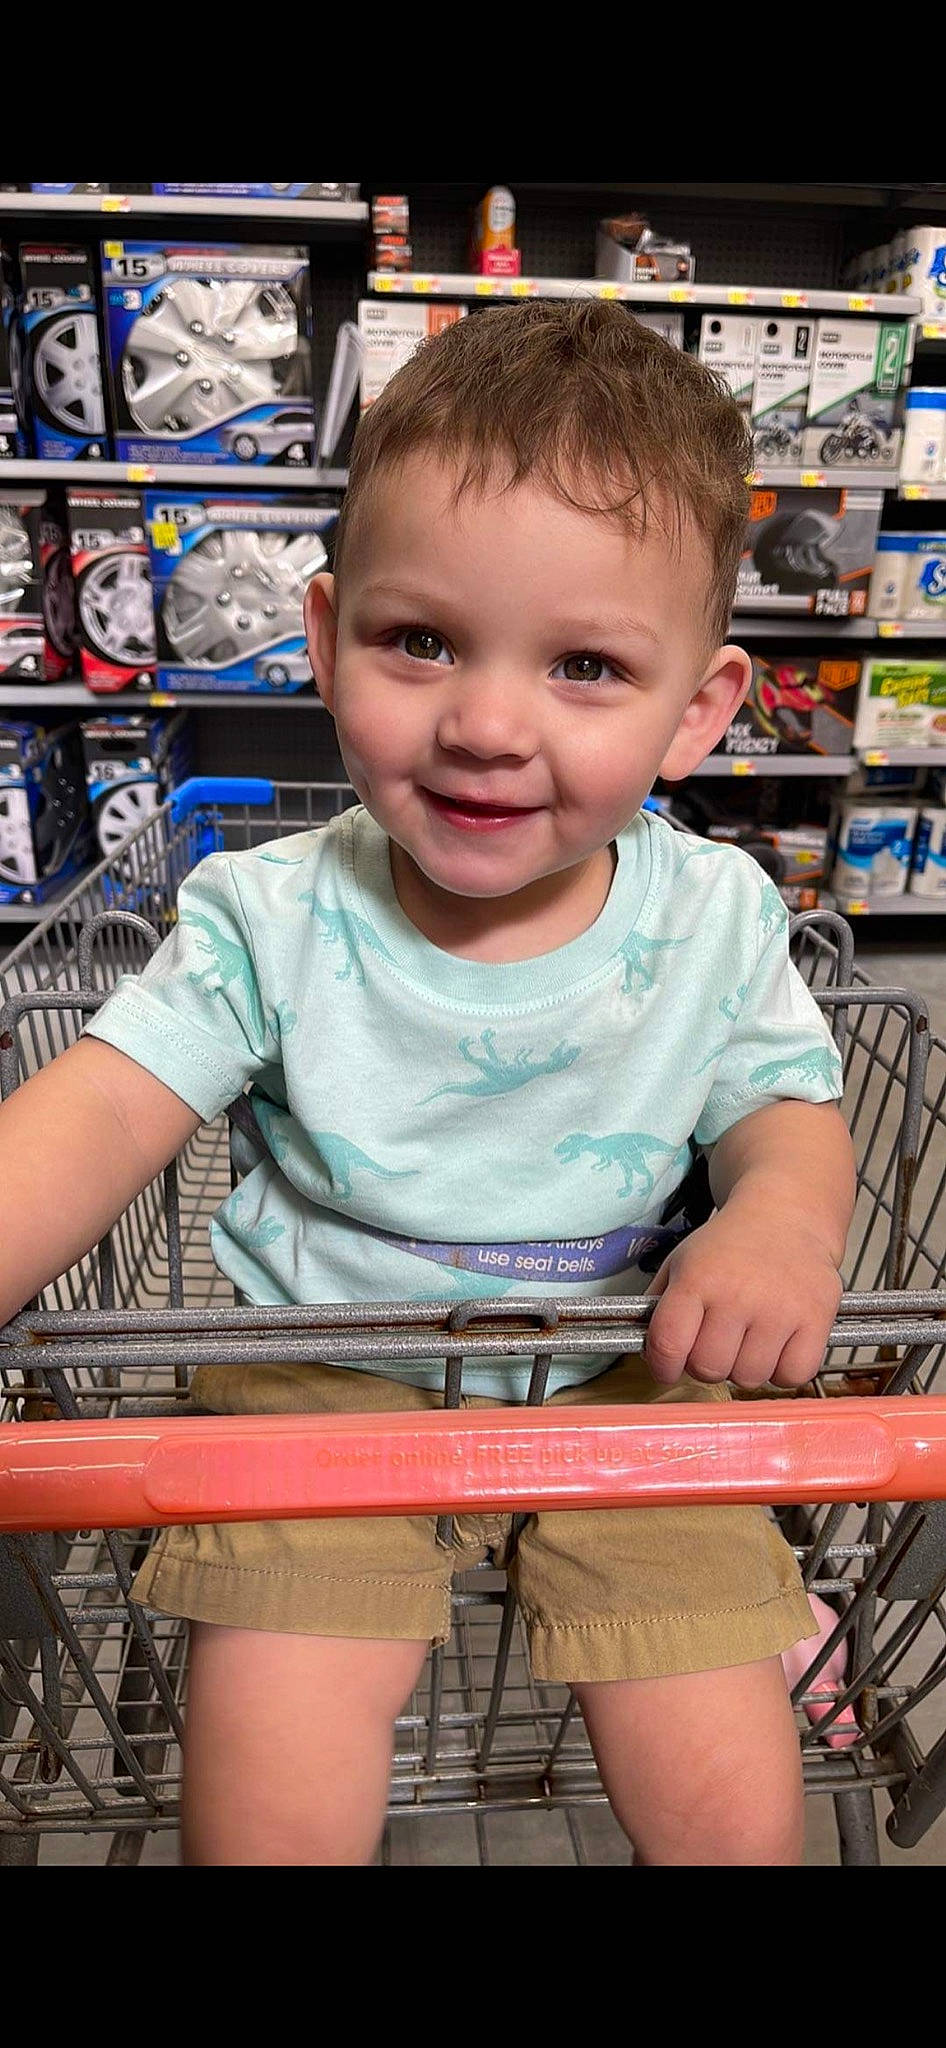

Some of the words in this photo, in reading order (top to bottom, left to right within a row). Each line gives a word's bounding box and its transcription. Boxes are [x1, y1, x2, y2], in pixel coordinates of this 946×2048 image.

[118, 258, 148, 277] 15
[478, 1249, 510, 1266] use
[515, 1256, 551, 1272] seat
[557, 1257, 595, 1273] belts.
[473, 1444, 533, 1464] FREE
[540, 1442, 587, 1465] pick
